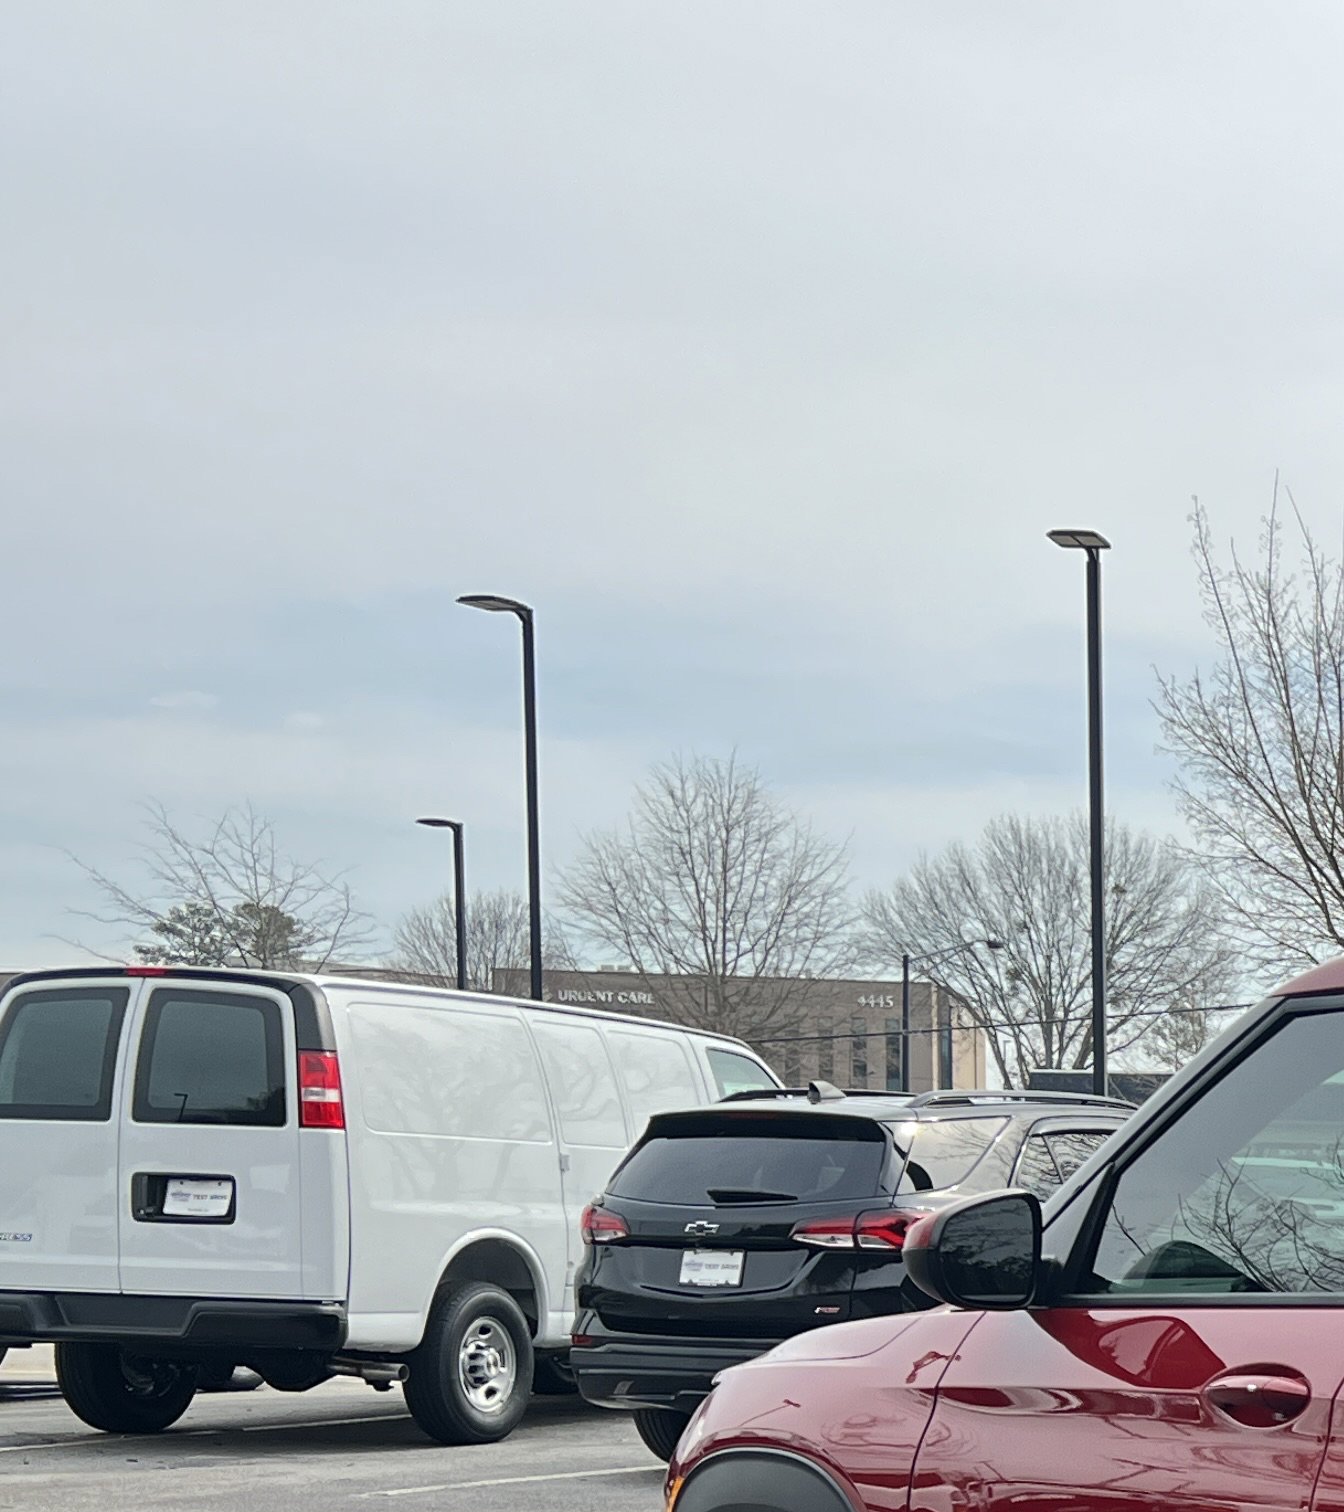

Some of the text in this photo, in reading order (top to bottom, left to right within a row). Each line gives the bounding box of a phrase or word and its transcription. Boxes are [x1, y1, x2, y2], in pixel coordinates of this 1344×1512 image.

[558, 990, 655, 1004] URGENT CARE
[857, 994, 894, 1008] 4445
